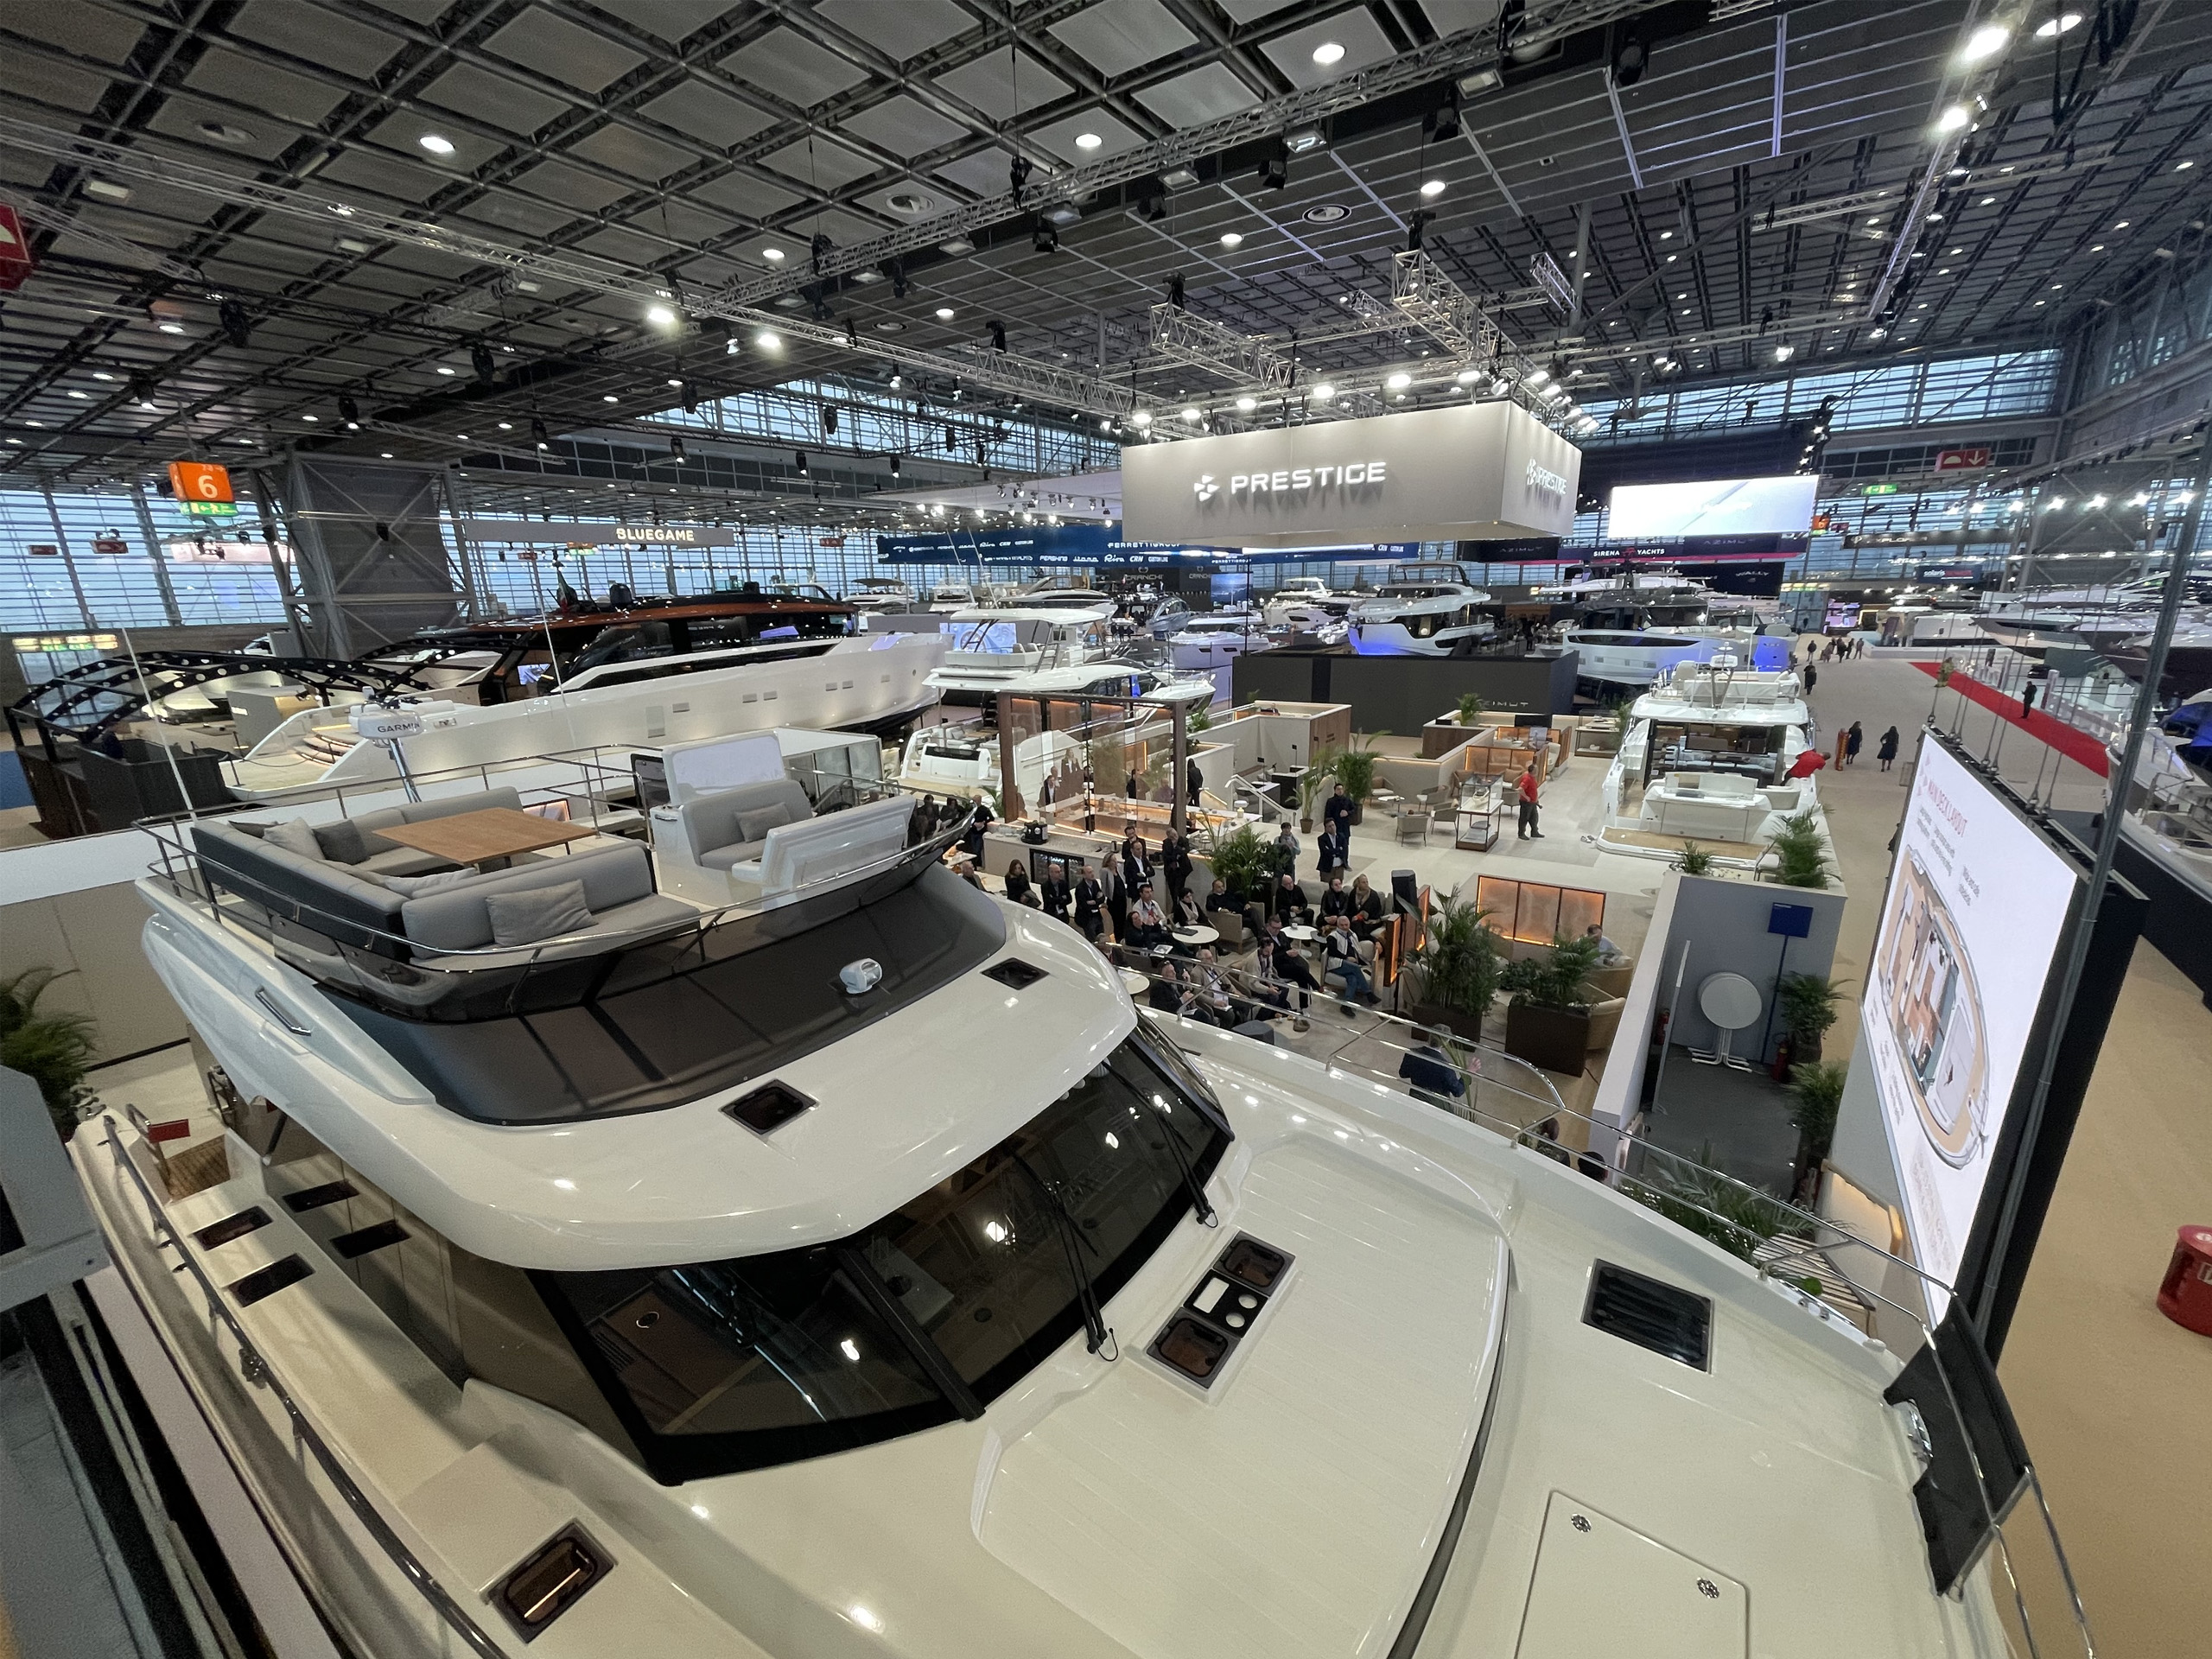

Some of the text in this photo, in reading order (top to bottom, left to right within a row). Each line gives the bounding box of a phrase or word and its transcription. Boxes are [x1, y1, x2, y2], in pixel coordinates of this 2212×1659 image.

[198, 474, 219, 499] 6
[1230, 461, 1387, 494] PRESTIGE
[616, 528, 695, 542] BLUEGAME
[378, 722, 421, 733] GARMIN
